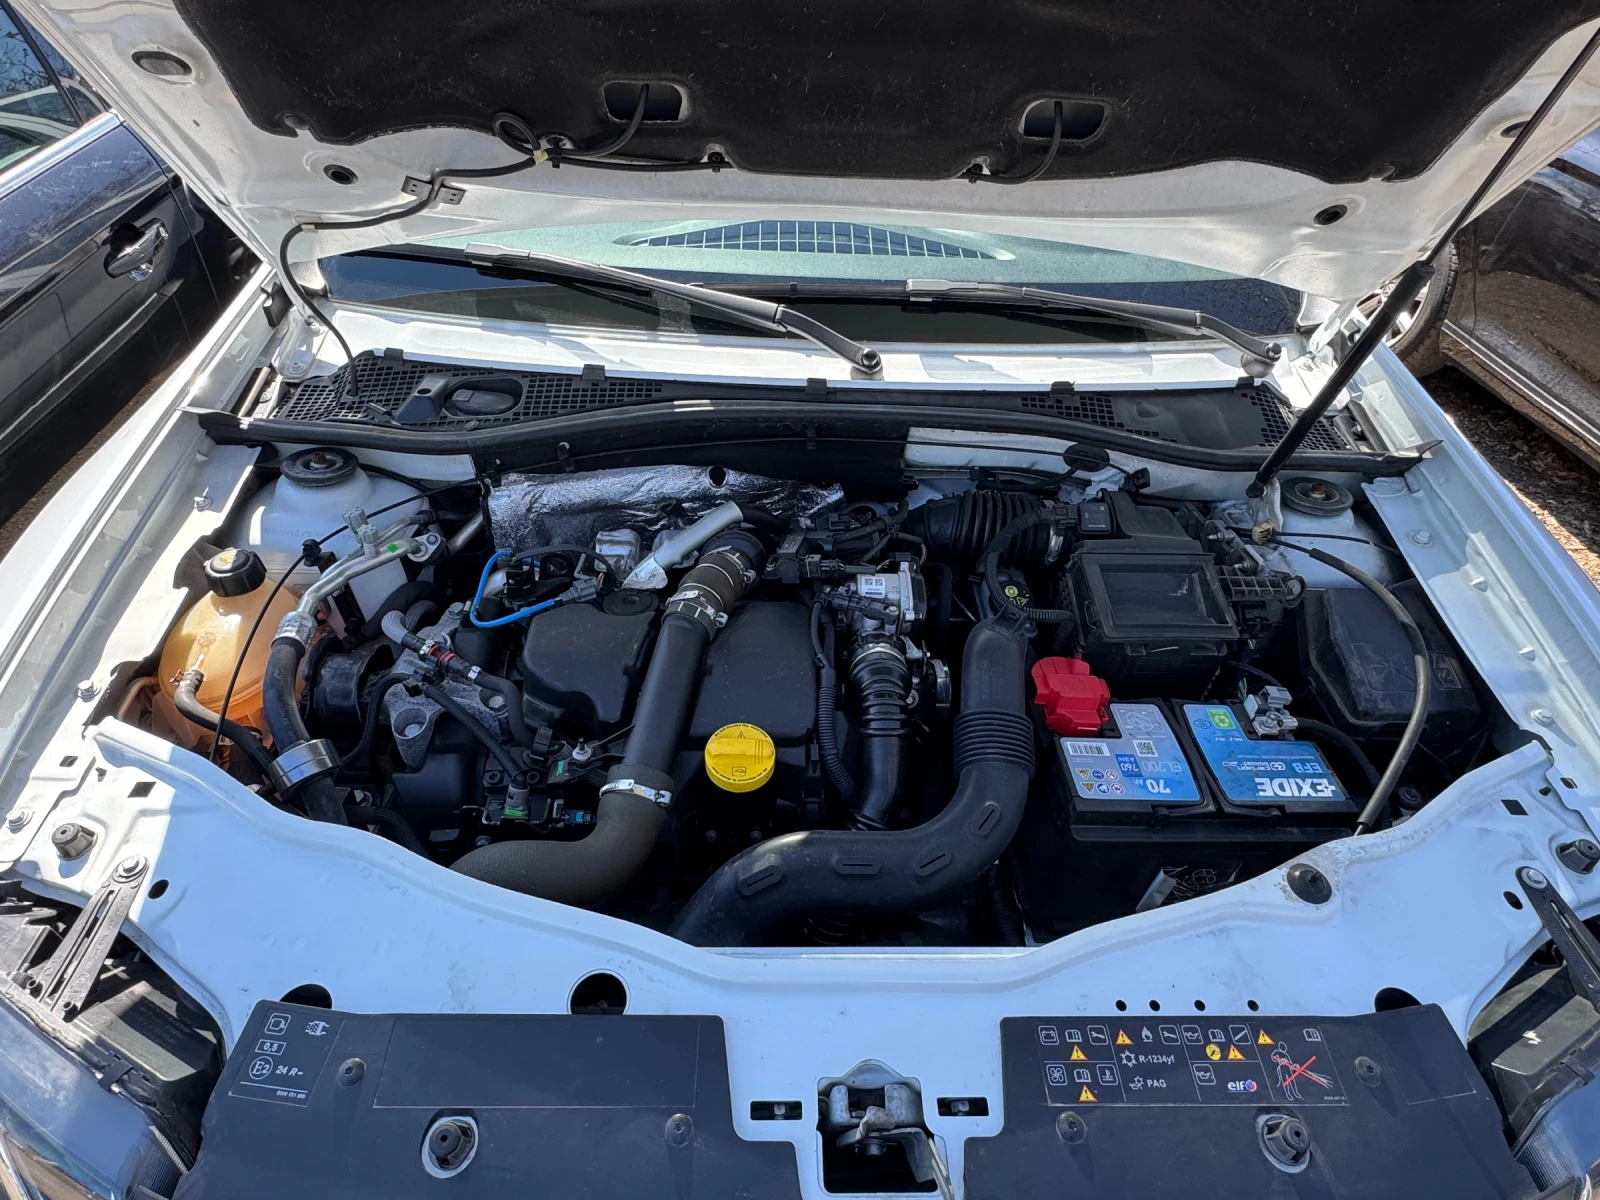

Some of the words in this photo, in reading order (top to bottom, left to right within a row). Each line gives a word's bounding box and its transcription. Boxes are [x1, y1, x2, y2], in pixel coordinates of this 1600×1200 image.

[1120, 761, 1139, 772] 760
[1141, 760, 1183, 773] EL700
[1292, 762, 1324, 774] EFB
[1131, 778, 1143, 786] Ah
[1145, 779, 1172, 794] 70
[1255, 777, 1337, 797] EXIDE
[263, 1042, 279, 1052] 0,5
[251, 1061, 270, 1075] E2
[275, 1065, 288, 1074] 24
[1146, 1078, 1167, 1088] PAG
[1227, 1080, 1245, 1091] elf
